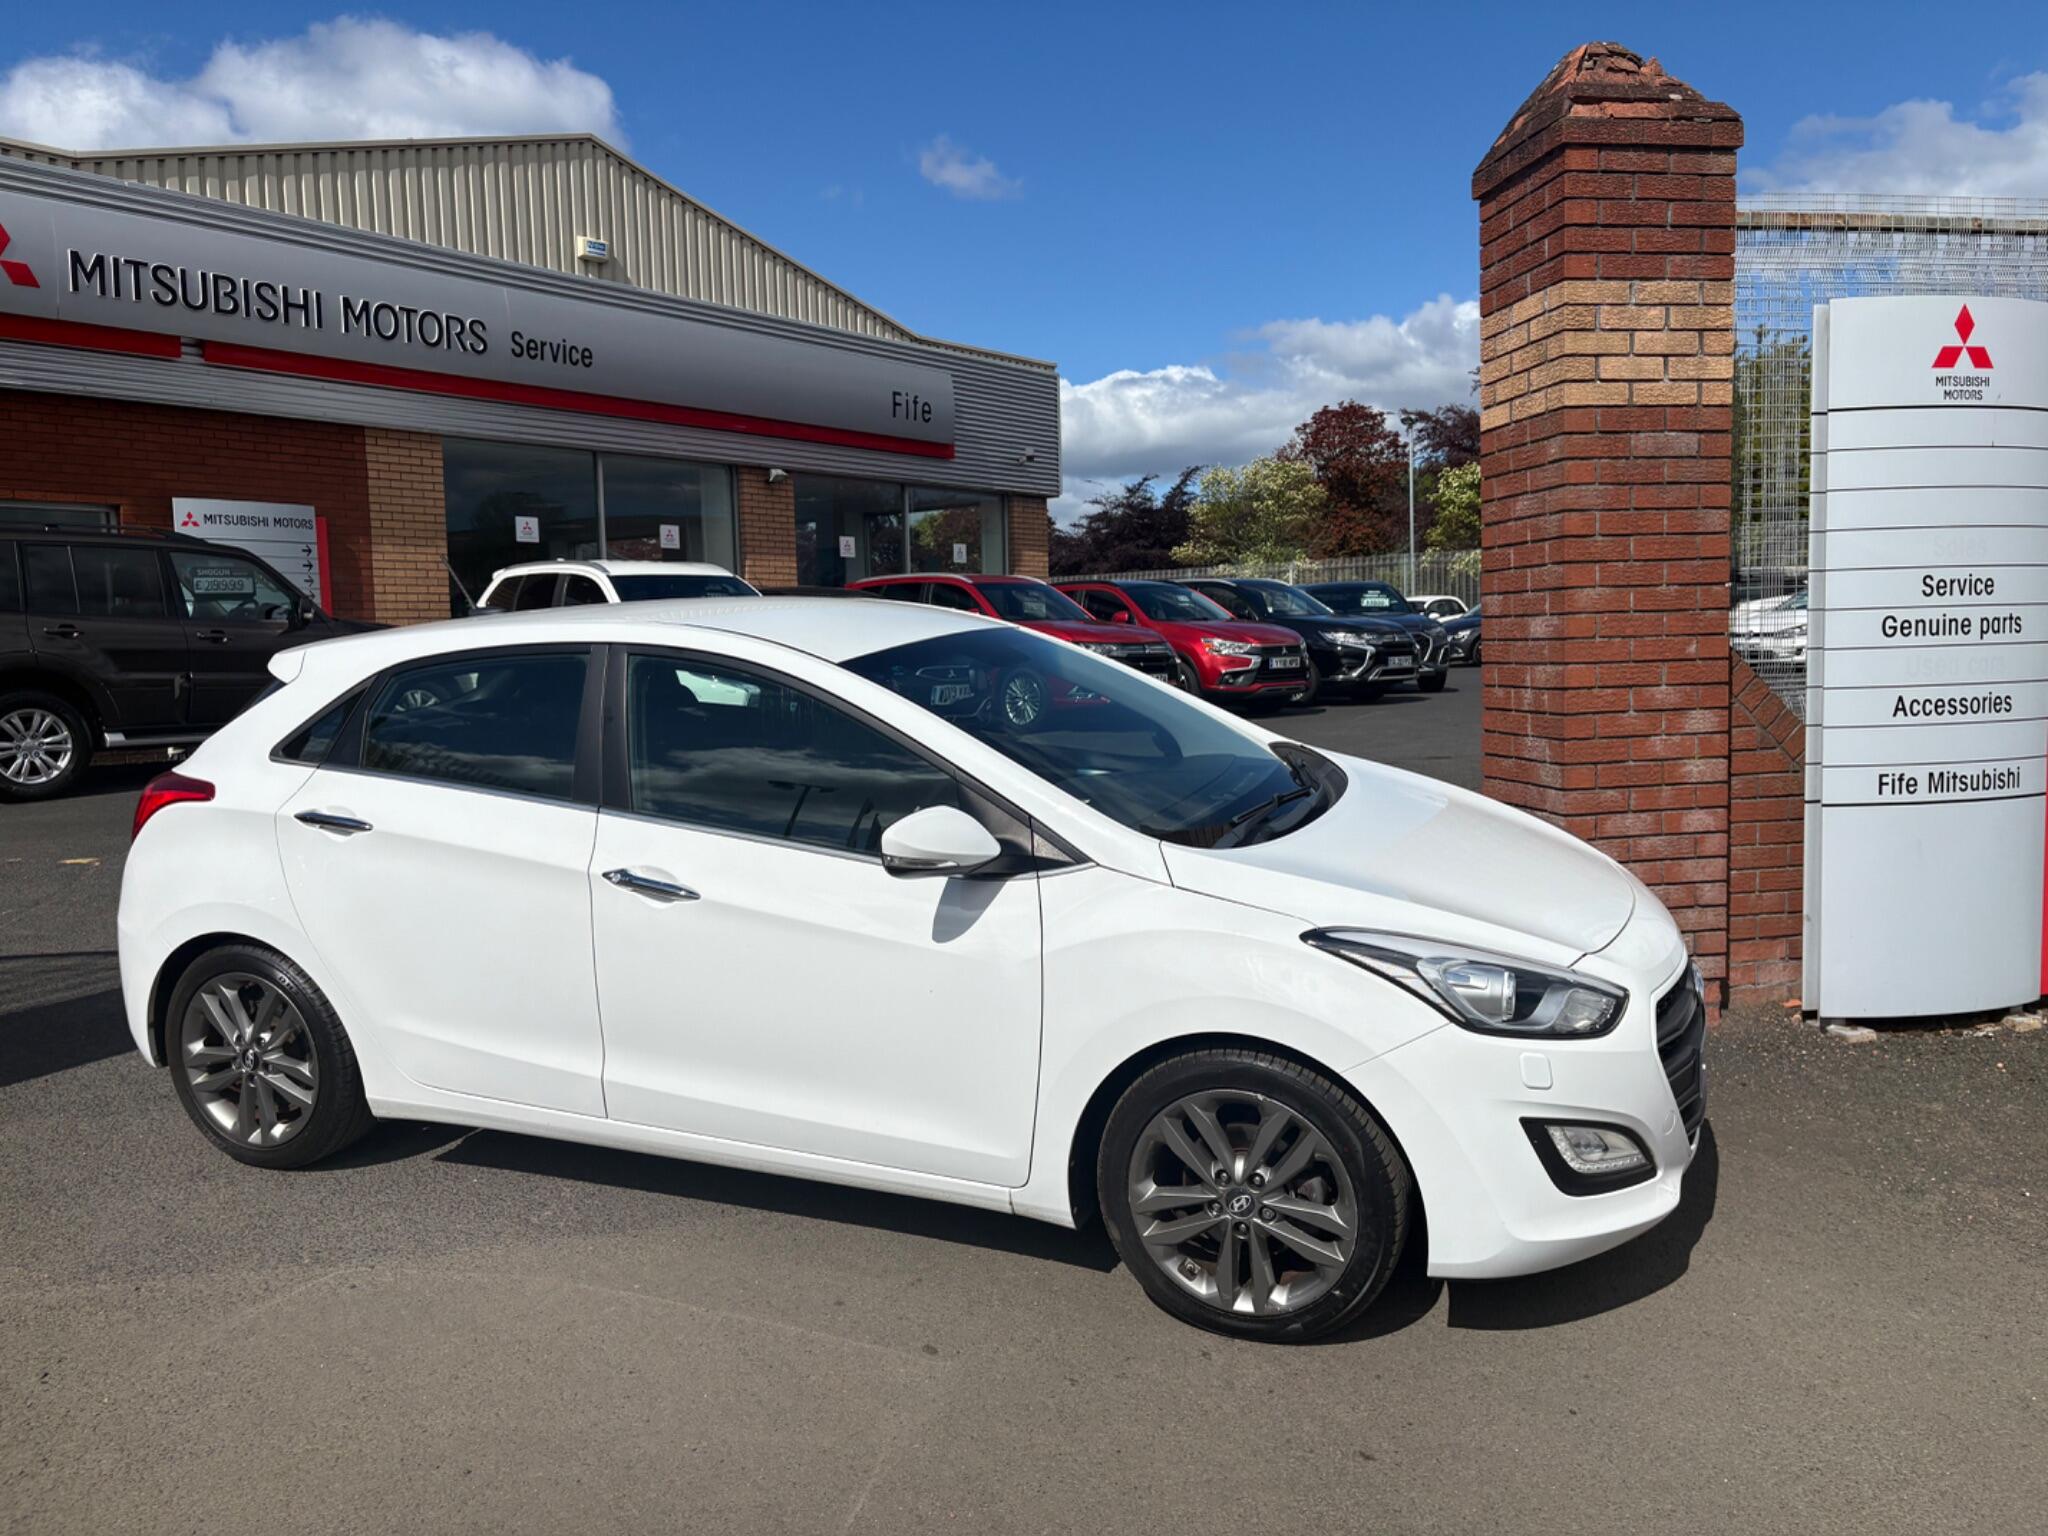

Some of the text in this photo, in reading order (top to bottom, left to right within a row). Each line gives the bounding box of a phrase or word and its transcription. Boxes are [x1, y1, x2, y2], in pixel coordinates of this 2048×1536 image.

[67, 248, 594, 368] MITSUBISHI MOTORS Service
[1935, 376, 1990, 387] MITSUBISHI
[1943, 389, 1983, 400] MOTORS
[892, 391, 932, 423] Fife
[203, 513, 314, 530] MITSUBISHI MOTORS
[1921, 573, 1995, 597] Service
[1881, 612, 2022, 640] Genuine parts
[1892, 691, 2013, 718] Accessories
[1877, 766, 2021, 796] Fife Mitsubishi
